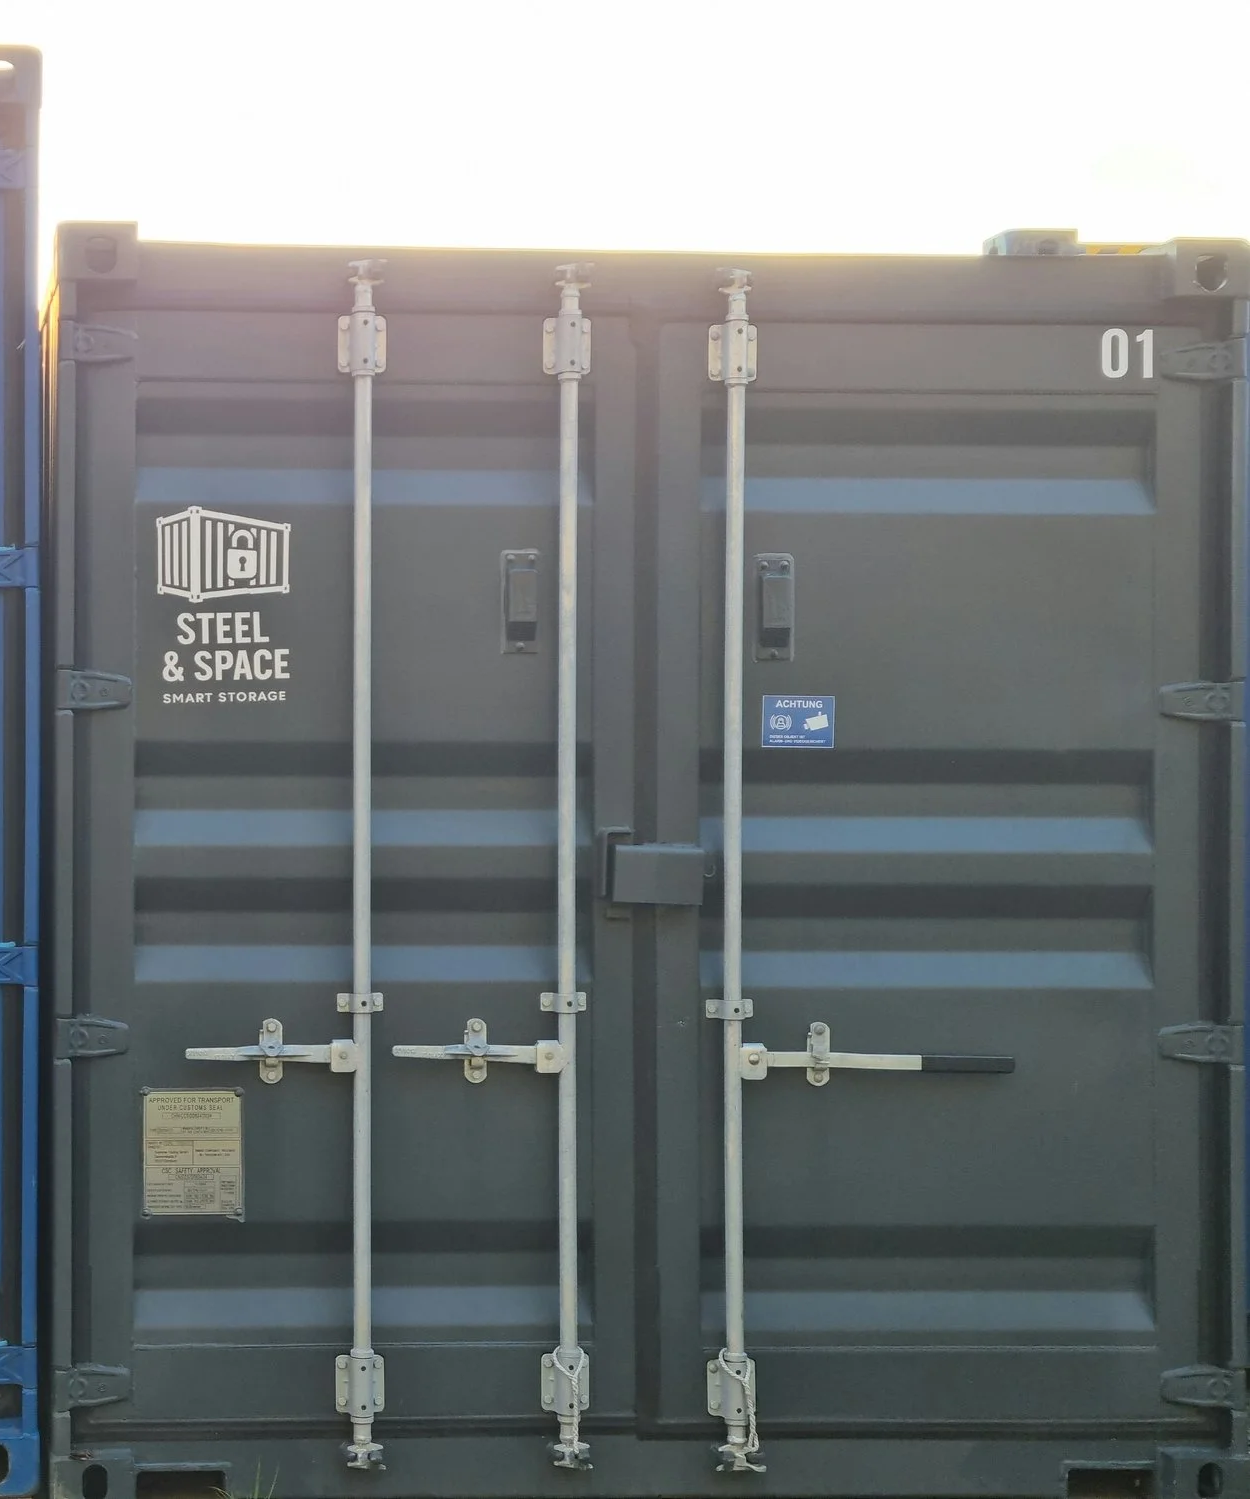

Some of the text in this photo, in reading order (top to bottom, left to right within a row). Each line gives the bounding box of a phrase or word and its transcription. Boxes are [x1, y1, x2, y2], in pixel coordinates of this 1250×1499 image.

[1101, 328, 1154, 379] 01
[176, 611, 270, 645] STEEL
[162, 649, 290, 682] & SPACE
[162, 690, 286, 704] SMART STORAGE
[775, 699, 823, 709] ACHTUNG
